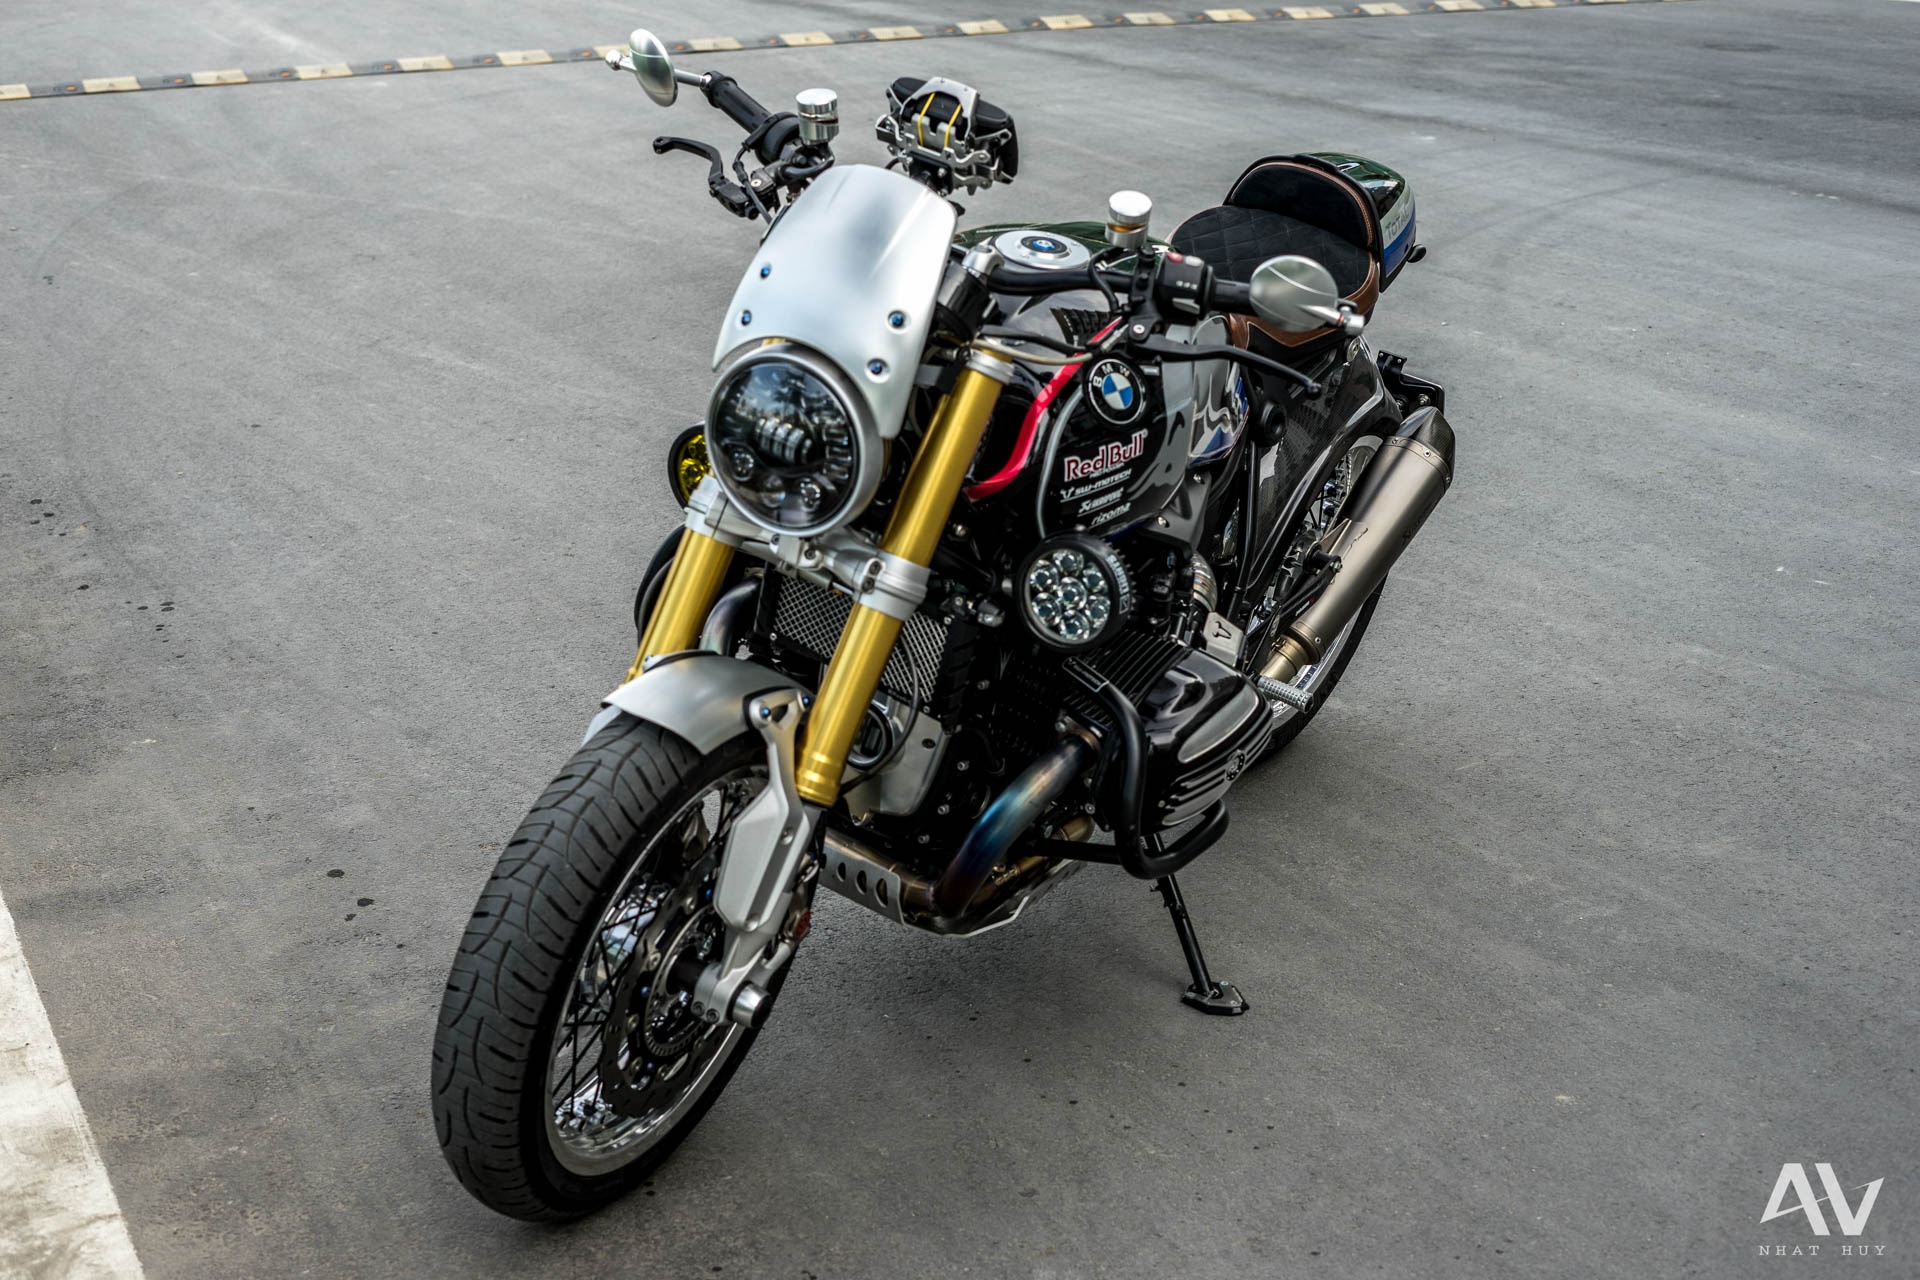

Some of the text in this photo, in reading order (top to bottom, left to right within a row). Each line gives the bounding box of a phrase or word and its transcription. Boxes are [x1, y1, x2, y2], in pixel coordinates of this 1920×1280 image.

[1092, 362, 1130, 388] BMW
[1064, 445, 1107, 482] Red
[1108, 429, 1146, 467] Bull
